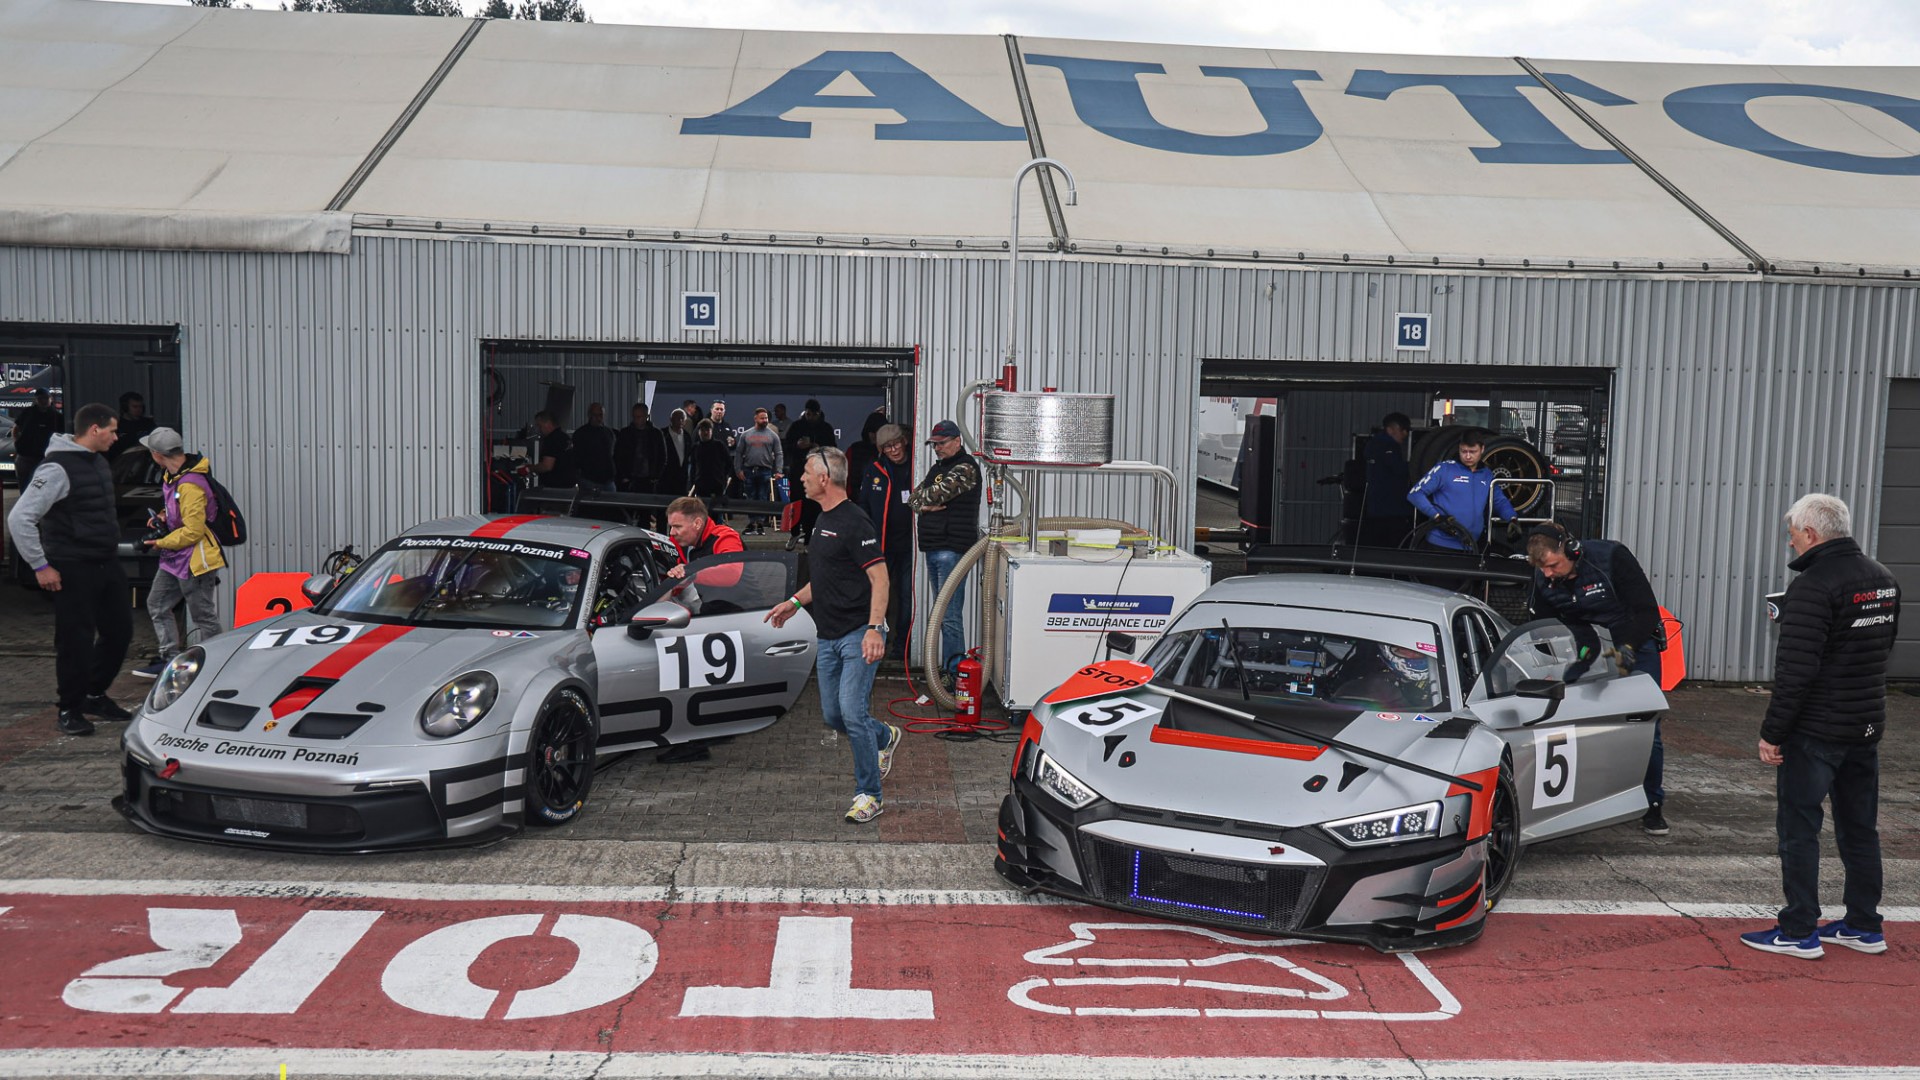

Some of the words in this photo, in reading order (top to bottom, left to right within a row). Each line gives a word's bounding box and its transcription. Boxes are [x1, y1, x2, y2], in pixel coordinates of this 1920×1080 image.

[690, 303, 710, 319] 19
[1403, 324, 1422, 340] 18
[399, 538, 450, 548] Porsche
[451, 538, 511, 552] Centrum
[511, 544, 564, 559] Poznań
[1047, 617, 1070, 626] 992
[1073, 617, 1141, 628] ENDURANCE
[1143, 619, 1166, 628] CUP
[270, 625, 350, 648] 19
[664, 632, 737, 689] 19
[1078, 667, 1140, 687] STOP
[1078, 703, 1146, 726] 5
[154, 733, 208, 752] Porsche
[215, 741, 286, 760] Centrum
[292, 748, 359, 766] Poznań
[1543, 732, 1569, 798] 5
